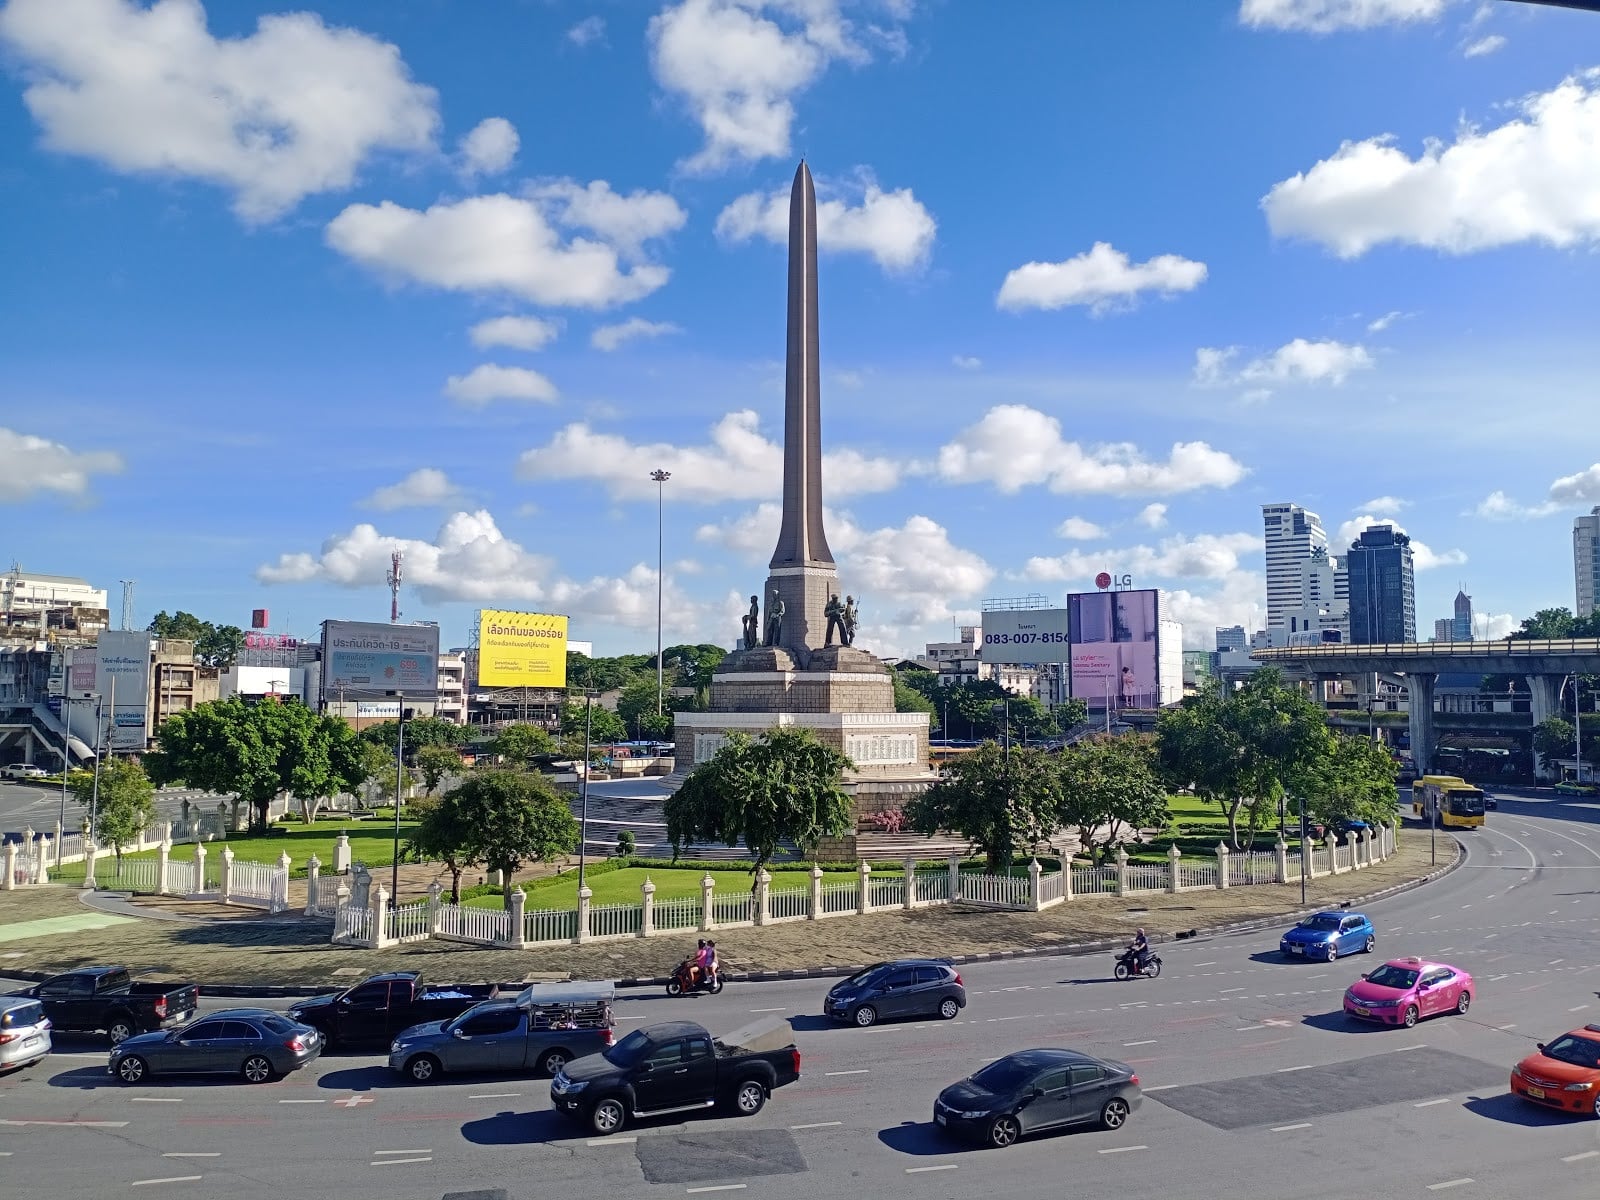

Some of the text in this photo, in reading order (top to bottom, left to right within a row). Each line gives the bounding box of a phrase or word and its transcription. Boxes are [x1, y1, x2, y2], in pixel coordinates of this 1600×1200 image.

[1114, 574, 1132, 587] LG
[487, 623, 563, 639] เลือกกินของอร่อย
[333, 638, 400, 650] ประกันโควิด-19
